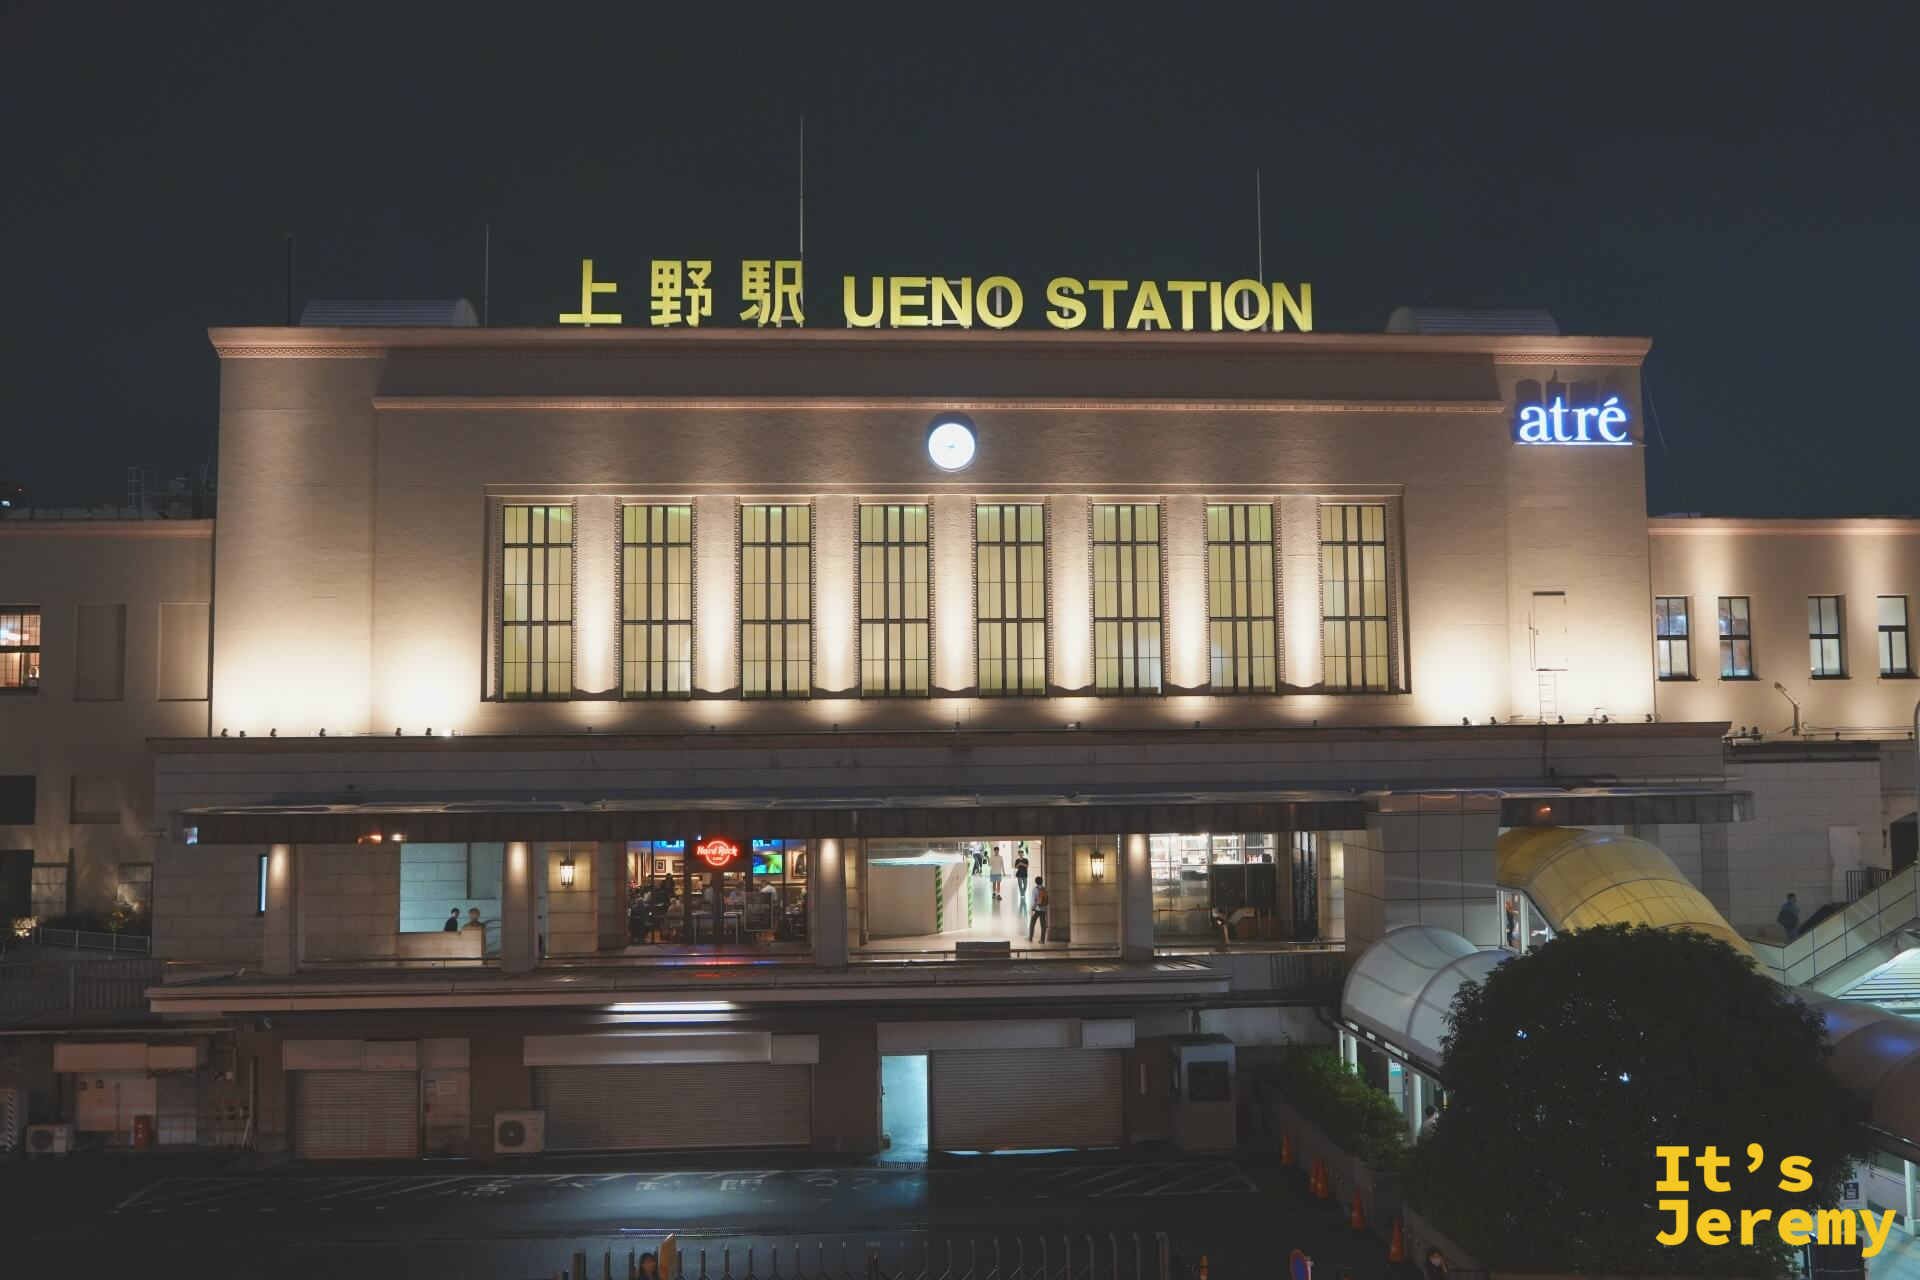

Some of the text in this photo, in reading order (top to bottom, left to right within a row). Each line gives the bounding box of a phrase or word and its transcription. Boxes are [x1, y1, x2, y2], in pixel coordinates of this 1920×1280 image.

[559, 258, 805, 327] 上野駅
[843, 275, 1313, 331] UENO STATION
[1518, 396, 1627, 442] atré
[697, 844, 738, 857] Hard Rock
